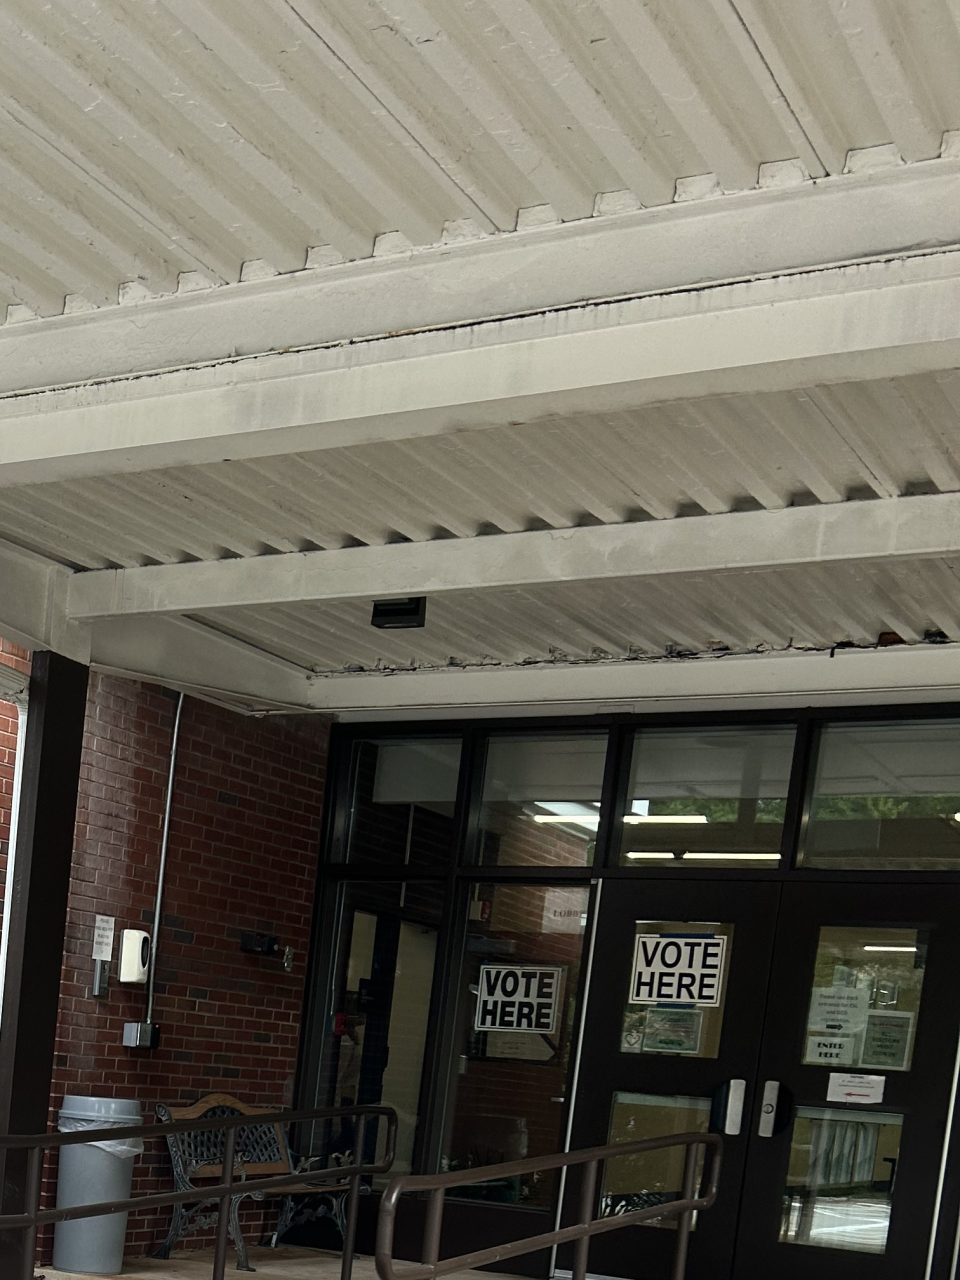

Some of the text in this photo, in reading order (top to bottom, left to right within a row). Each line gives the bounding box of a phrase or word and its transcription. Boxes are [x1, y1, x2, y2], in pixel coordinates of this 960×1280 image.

[641, 940, 721, 970] VOTE
[484, 969, 555, 999] VOTE
[635, 971, 717, 1001] HERE
[479, 999, 553, 1029] HERE
